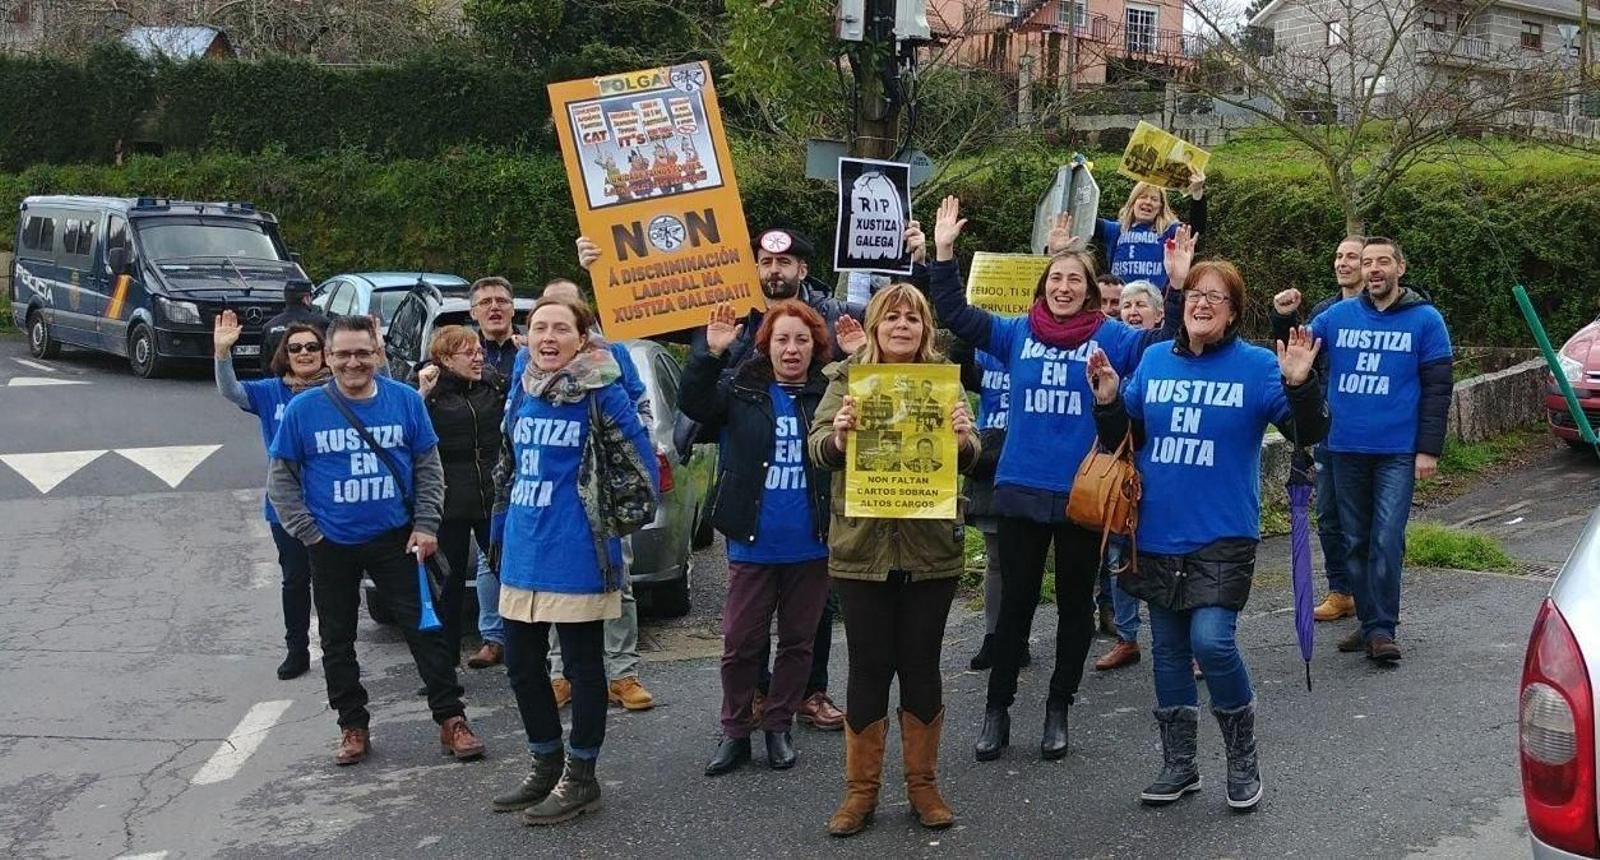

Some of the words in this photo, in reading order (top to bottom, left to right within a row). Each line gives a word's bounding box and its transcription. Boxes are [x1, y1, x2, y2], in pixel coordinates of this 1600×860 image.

[583, 131, 607, 144] CAT
[618, 133, 646, 147] IT'S
[858, 197, 889, 213] RIP
[611, 208, 720, 262] NN
[856, 219, 897, 231] XUSTIZA
[856, 236, 894, 247] GALEGA
[1129, 245, 1135, 259] E
[621, 246, 740, 284] DISCRIMINACIÓN
[632, 275, 700, 301] LABORAL
[1011, 287, 1019, 296] TI
[612, 298, 676, 323] XUSTIZA
[678, 283, 751, 310] GALEGA!!!
[1336, 328, 1411, 352] XUSTIZA
[1355, 352, 1381, 372] EN
[1041, 361, 1068, 387] EN
[1338, 373, 1389, 395] LOITA
[1024, 389, 1081, 415] LOITA
[1145, 379, 1244, 408] XUSTIZA
[514, 416, 581, 447] USTIZA
[1170, 406, 1202, 434] EN
[521, 449, 539, 476] EN
[775, 440, 801, 463] EN
[1151, 436, 1214, 467] LOITA
[350, 452, 379, 475] EN
[333, 476, 395, 503] LOITA
[765, 466, 807, 490] OIT
[891, 476, 929, 484] FALTAN
[857, 488, 896, 496] CARTOS
[899, 488, 938, 496] SOBRAN
[860, 499, 892, 507] ALTOS
[895, 500, 935, 508] CARGOS
